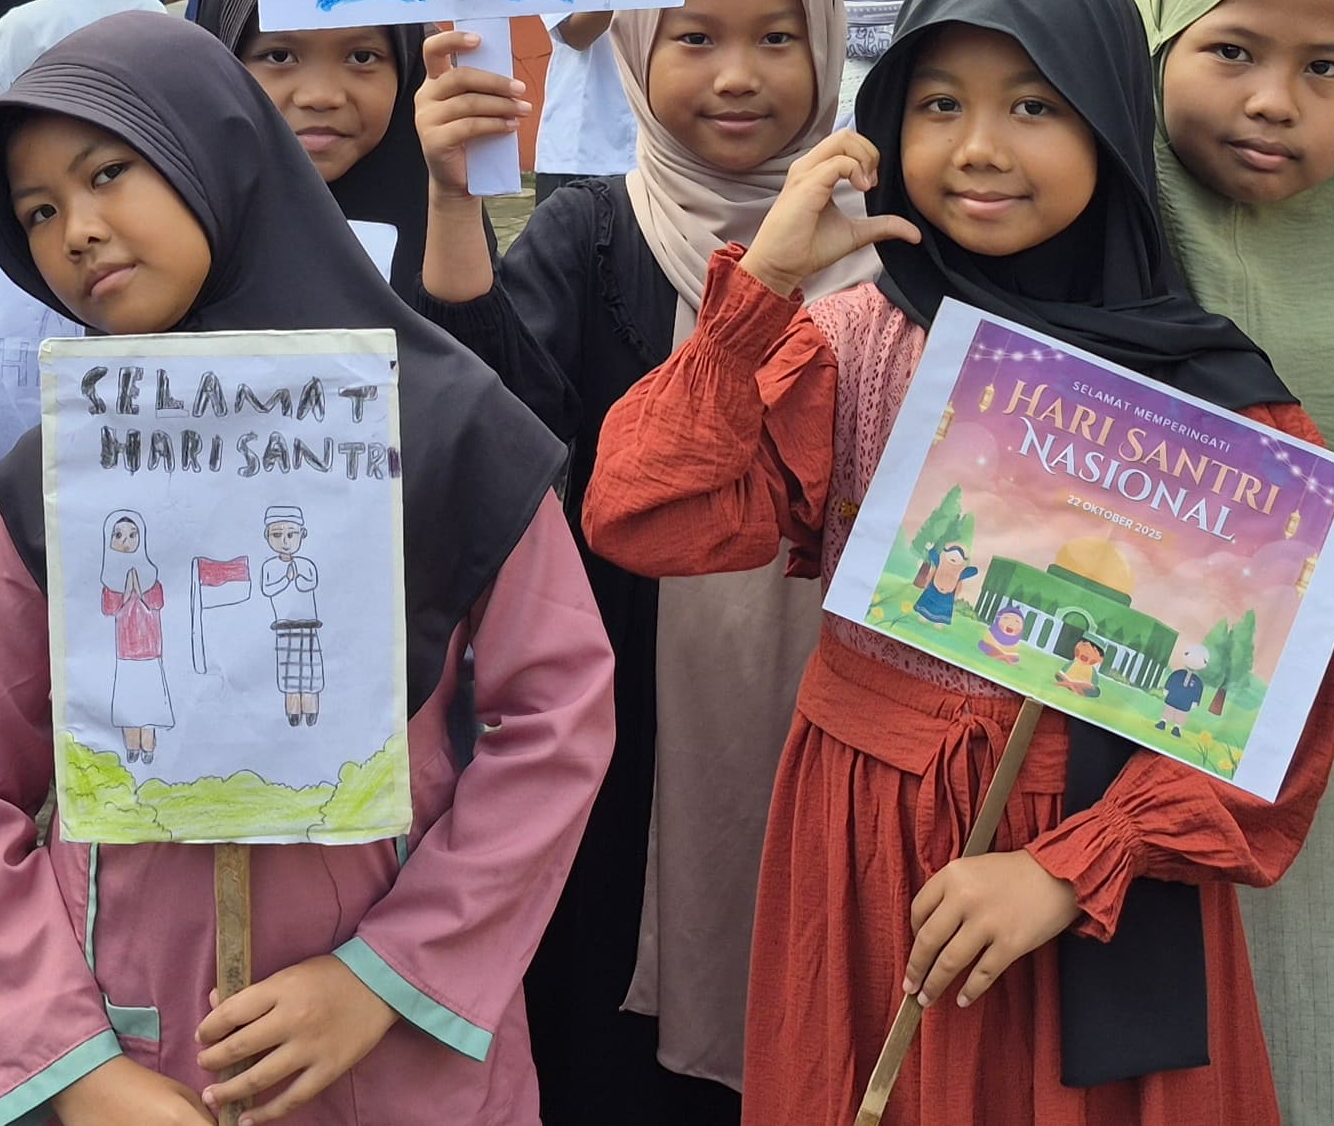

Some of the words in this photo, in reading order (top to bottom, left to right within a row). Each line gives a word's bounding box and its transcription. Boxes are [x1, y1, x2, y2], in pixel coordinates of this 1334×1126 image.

[80, 364, 379, 424] SELAMAT
[1072, 380, 1132, 411] SELAMAT
[1134, 406, 1231, 453] MEMPERINGATI
[99, 425, 224, 476] HARI
[235, 430, 402, 480] SANTRI
[1002, 378, 1116, 448] HARI
[1118, 427, 1283, 516] SANTRI
[1017, 416, 1237, 542] NASIONAL
[1066, 494, 1081, 507] 22
[1082, 500, 1134, 530] OKTOBER
[1134, 523, 1164, 541] 2025
